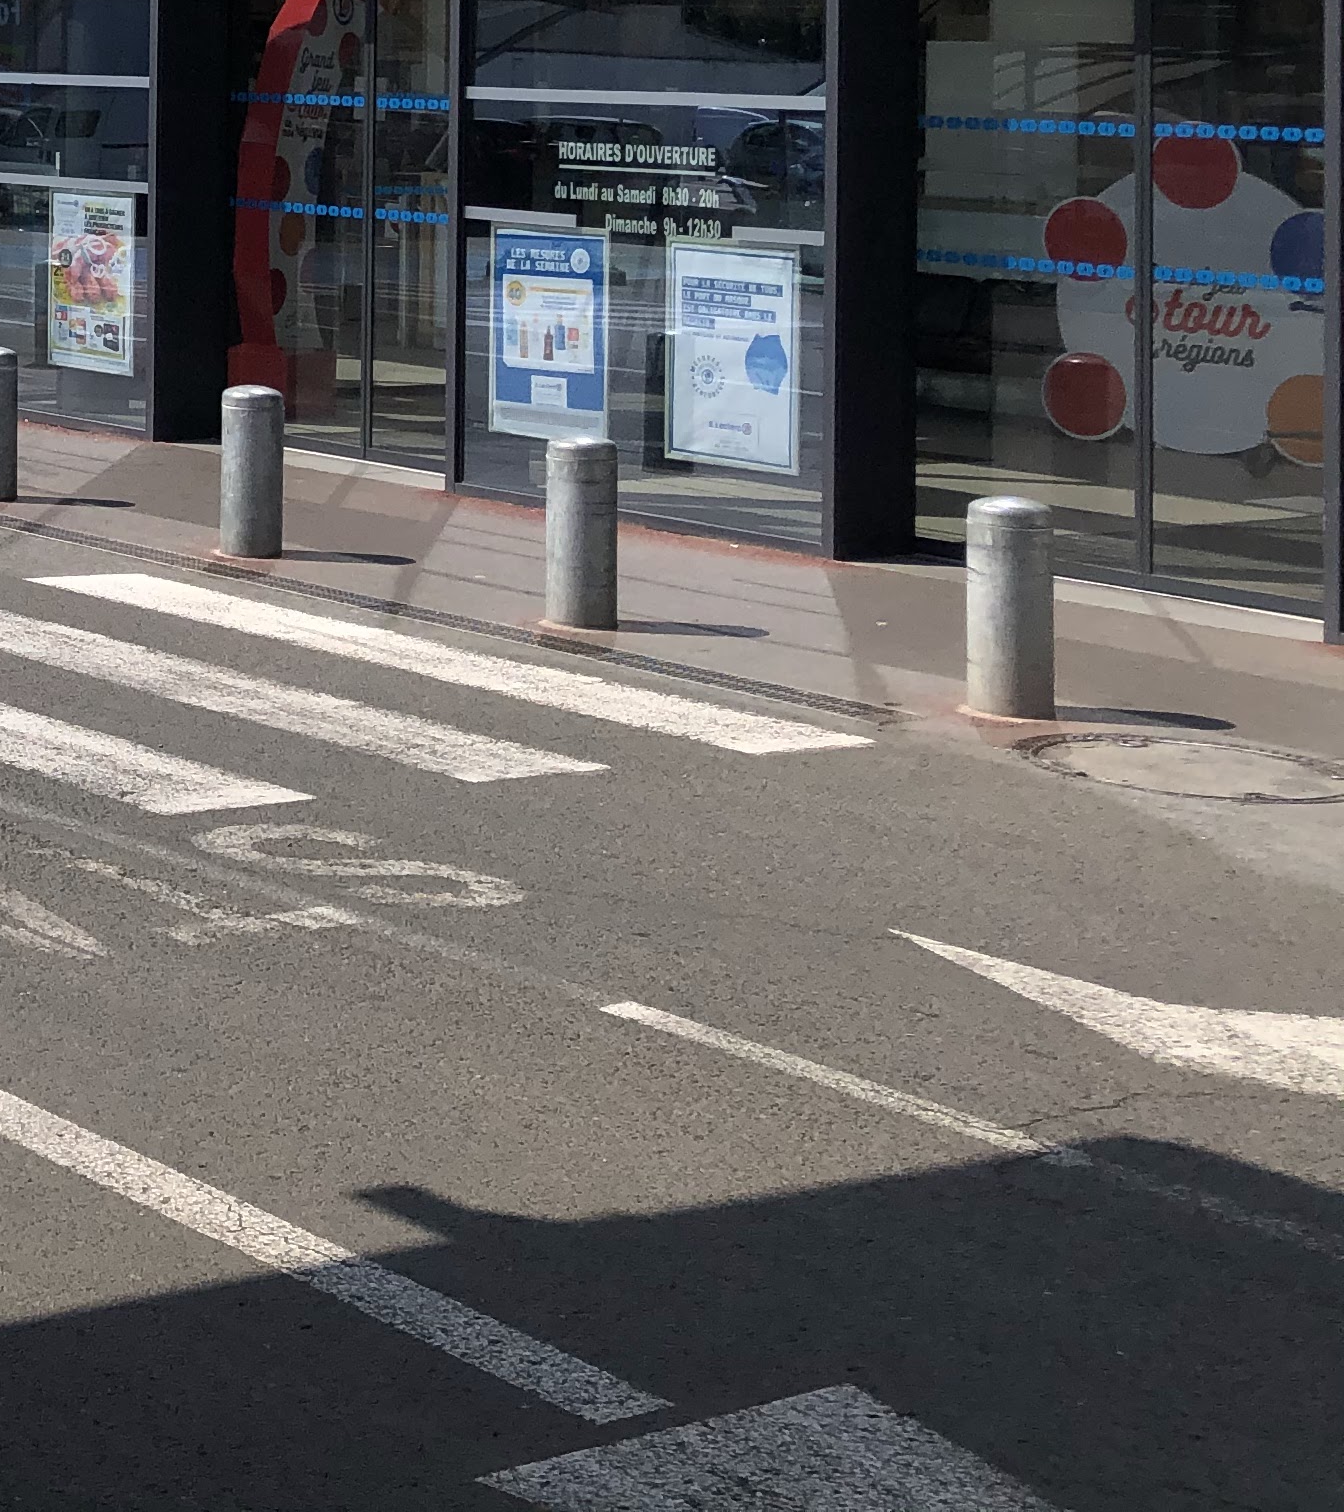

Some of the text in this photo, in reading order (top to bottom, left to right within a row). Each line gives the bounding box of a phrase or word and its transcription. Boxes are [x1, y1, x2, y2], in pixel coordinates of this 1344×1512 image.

[300, 46, 335, 74] Grand
[558, 141, 716, 166] HORAIRES D'OUVERTURE
[554, 181, 567, 199] du
[570, 182, 598, 201] Lundi
[601, 188, 614, 202] au
[616, 185, 656, 206] Samedi
[662, 187, 689, 207] 8h30
[698, 188, 720, 208] 20h
[605, 213, 657, 235] Dimanche
[663, 216, 677, 236] 9h
[686, 218, 721, 239] 12h30
[1163, 289, 1272, 340] tour
[1161, 335, 1255, 373] régions
